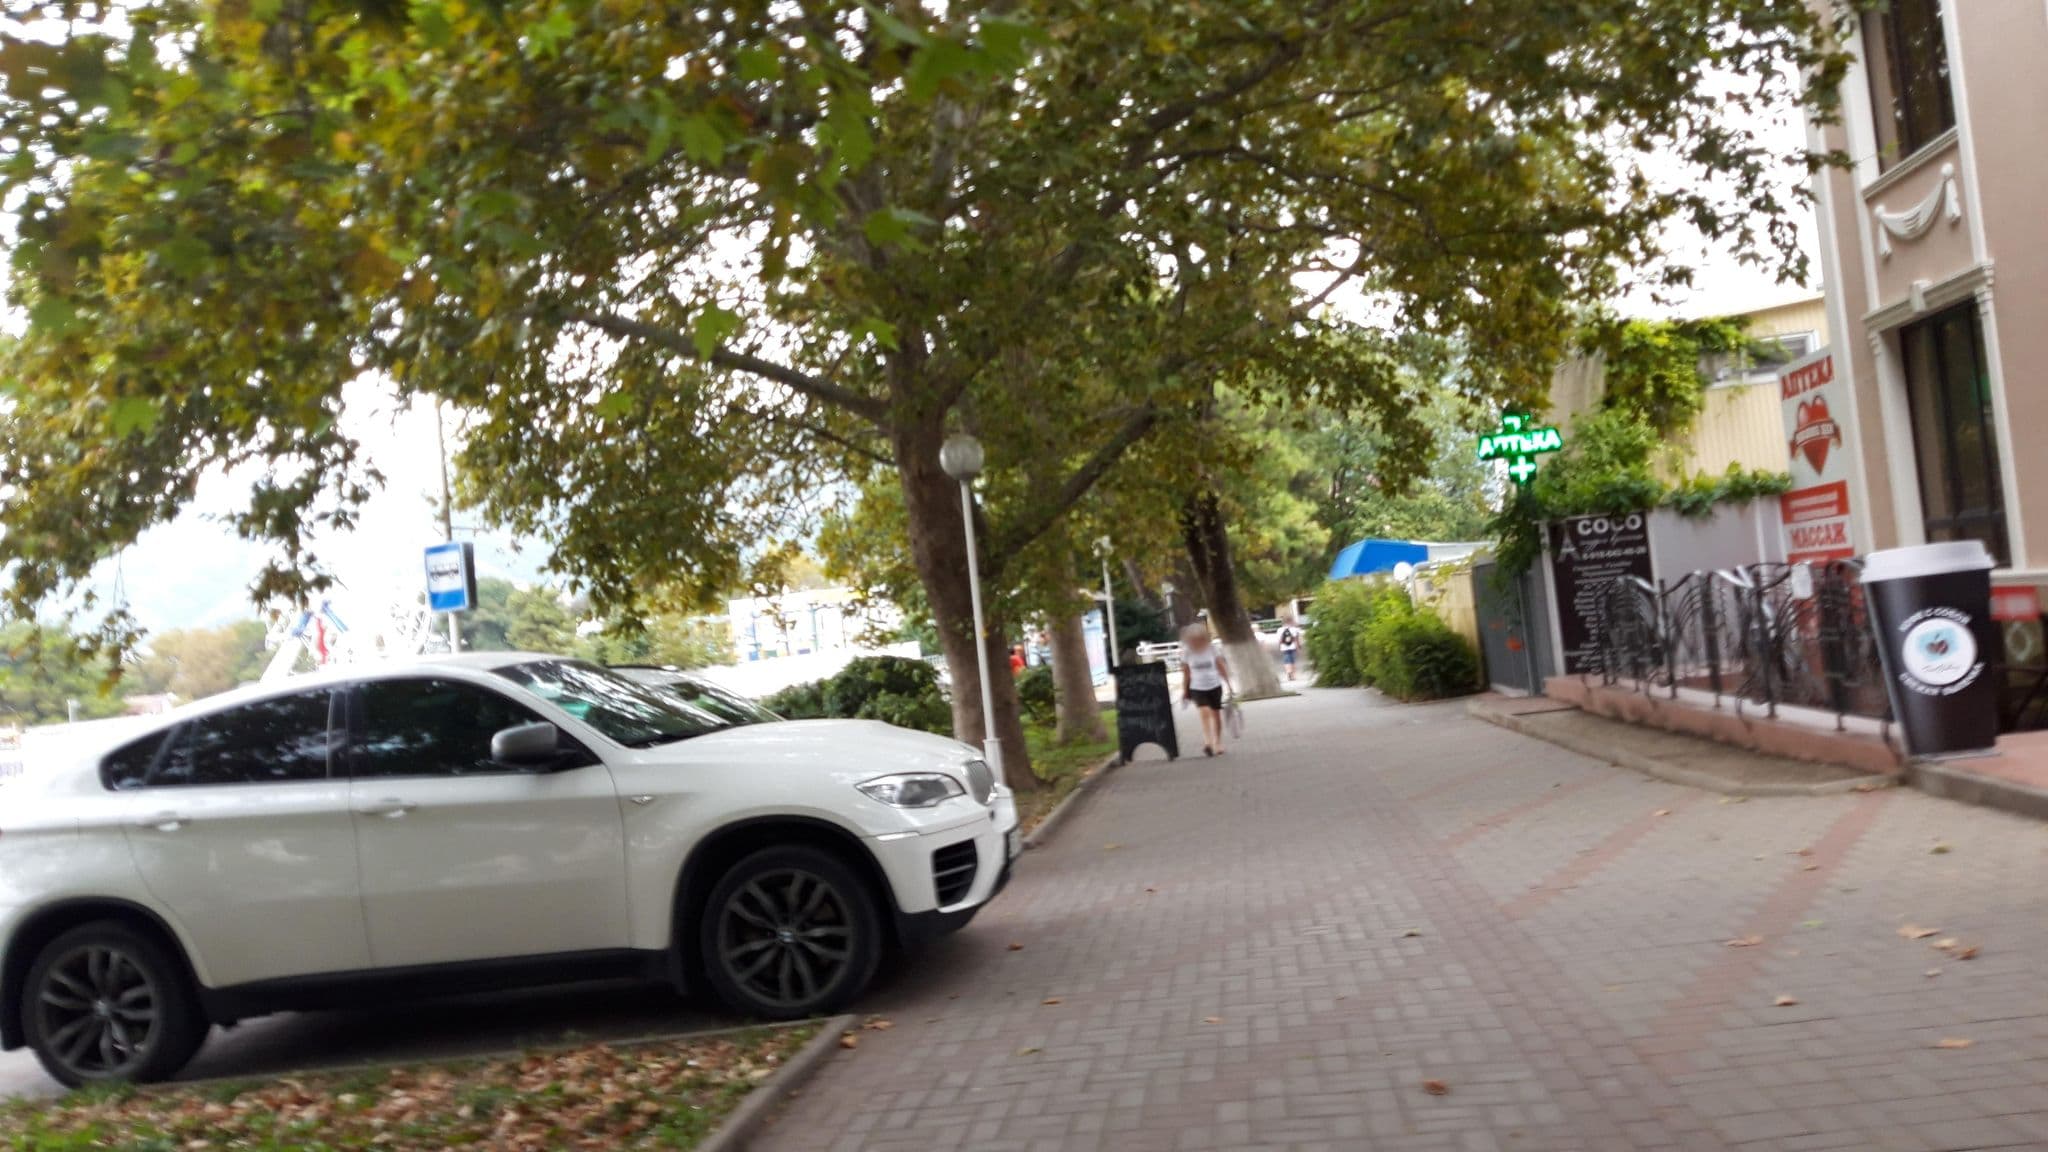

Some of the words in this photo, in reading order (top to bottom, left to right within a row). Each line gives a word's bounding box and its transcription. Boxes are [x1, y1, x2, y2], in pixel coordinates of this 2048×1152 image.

[1781, 355, 1833, 400] АПТЕКА
[1479, 428, 1562, 458] АПТЕКА
[1791, 522, 1847, 549] МАССАЖ
